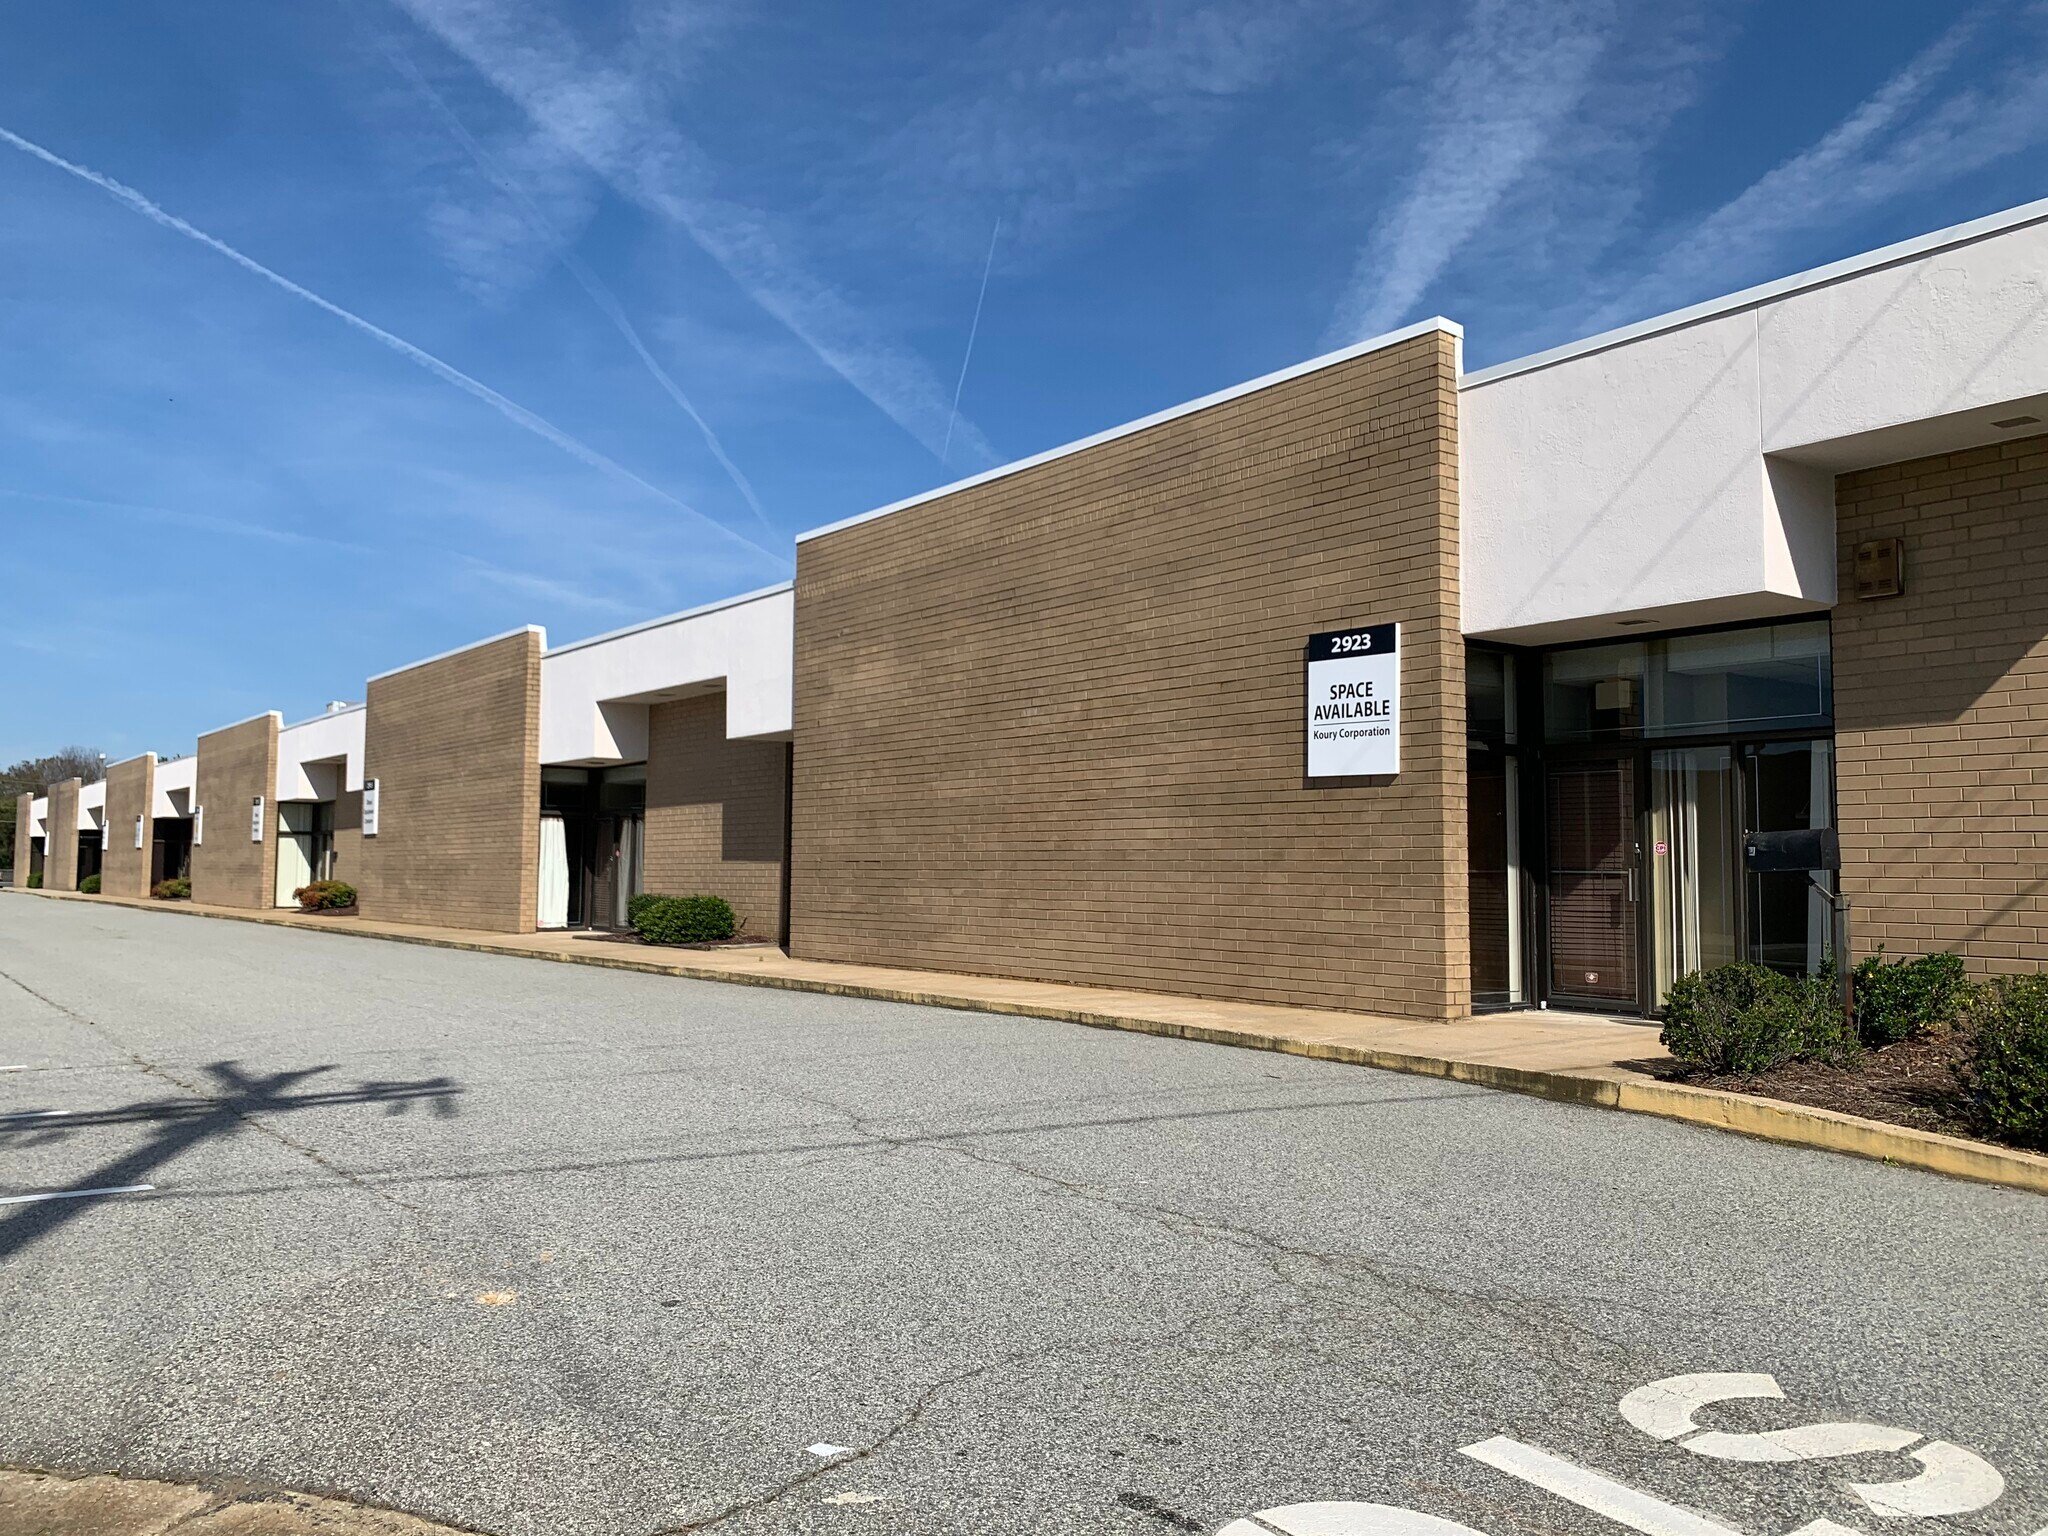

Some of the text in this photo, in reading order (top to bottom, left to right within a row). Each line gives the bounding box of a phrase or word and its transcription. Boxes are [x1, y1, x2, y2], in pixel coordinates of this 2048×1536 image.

[1331, 633, 1371, 653] 2923
[1330, 681, 1373, 700] SPACE
[1314, 700, 1390, 720] AVAILABLE
[1313, 726, 1390, 741] Koury Corporation
